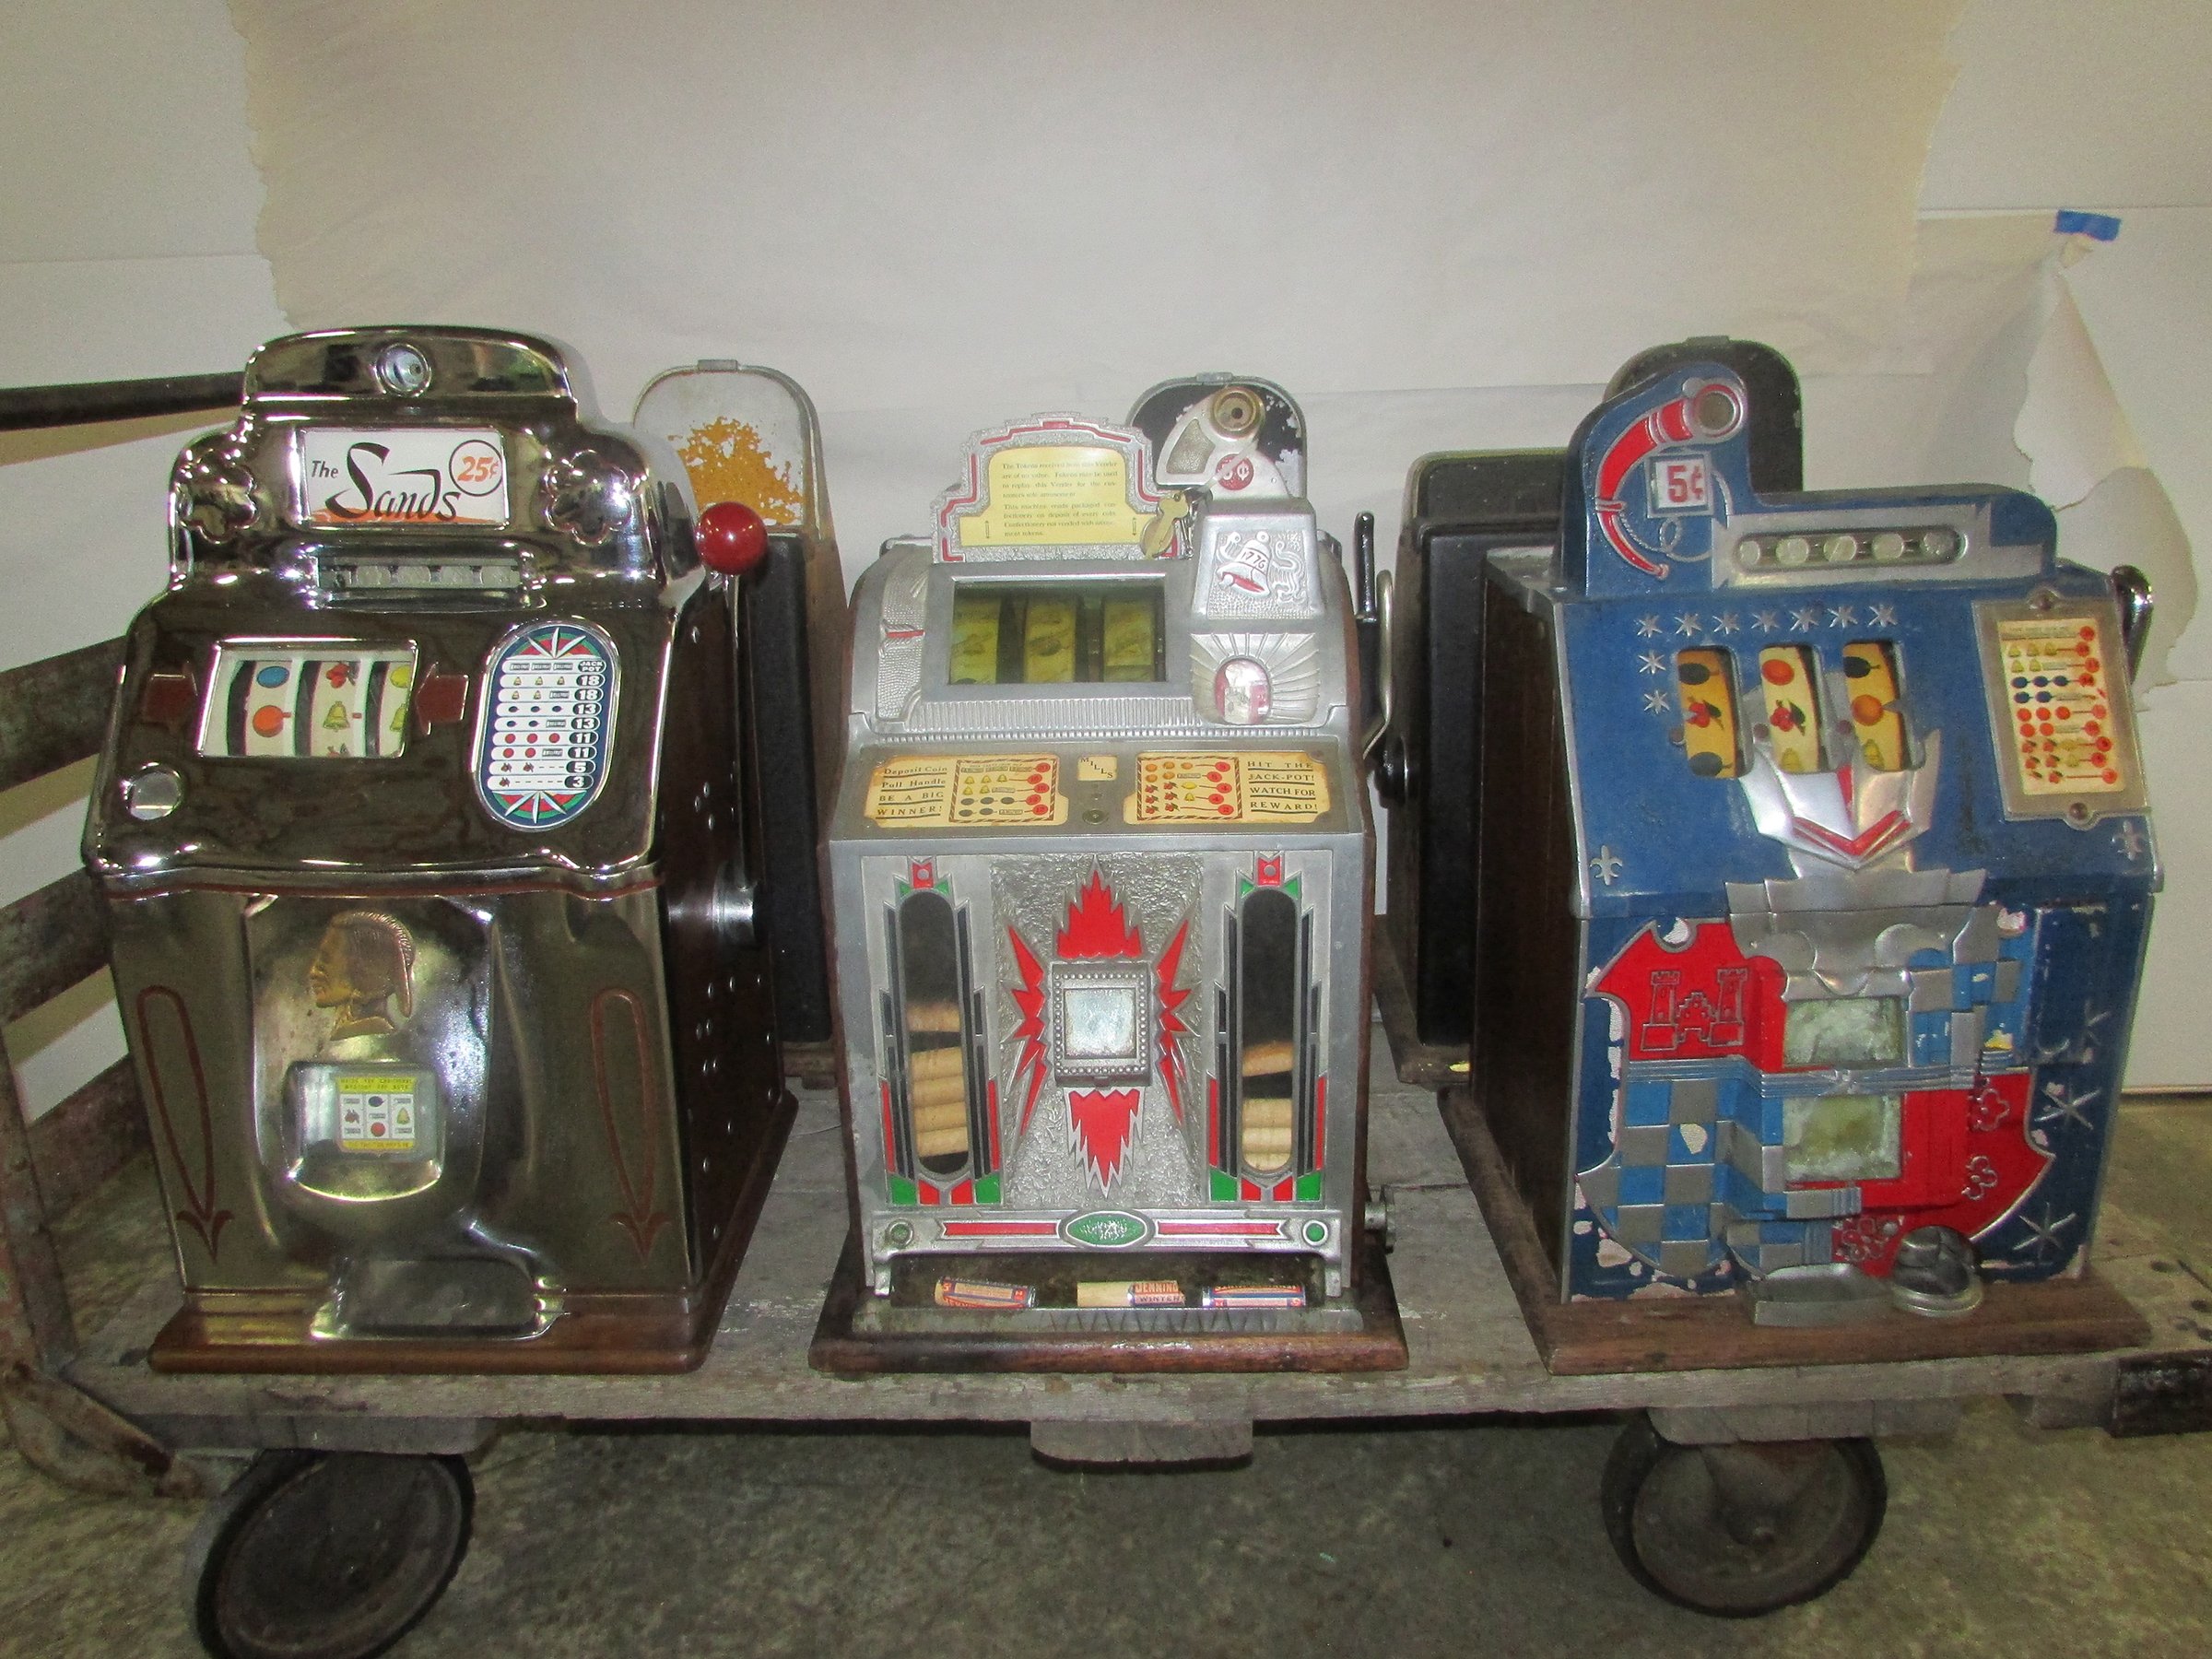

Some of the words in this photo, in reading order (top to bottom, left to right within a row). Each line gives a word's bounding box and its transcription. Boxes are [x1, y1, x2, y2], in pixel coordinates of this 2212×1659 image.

[457, 455, 499, 482] 25¢
[312, 460, 338, 478] The
[325, 441, 461, 522] Sands
[1666, 465, 1703, 502] 5¢
[1241, 550, 1267, 570] 1776
[581, 676, 600, 686] 18
[580, 689, 598, 700] 18
[578, 704, 596, 714] 13
[576, 718, 594, 729] 13
[576, 733, 591, 744] 11
[574, 747, 589, 758] 11
[574, 761, 587, 773] 5
[884, 767, 922, 775] Deposit
[1080, 758, 1113, 778] MILLS
[572, 776, 584, 788] 3
[877, 806, 942, 815] WINNER!
[1251, 801, 1318, 810] REWARD!
